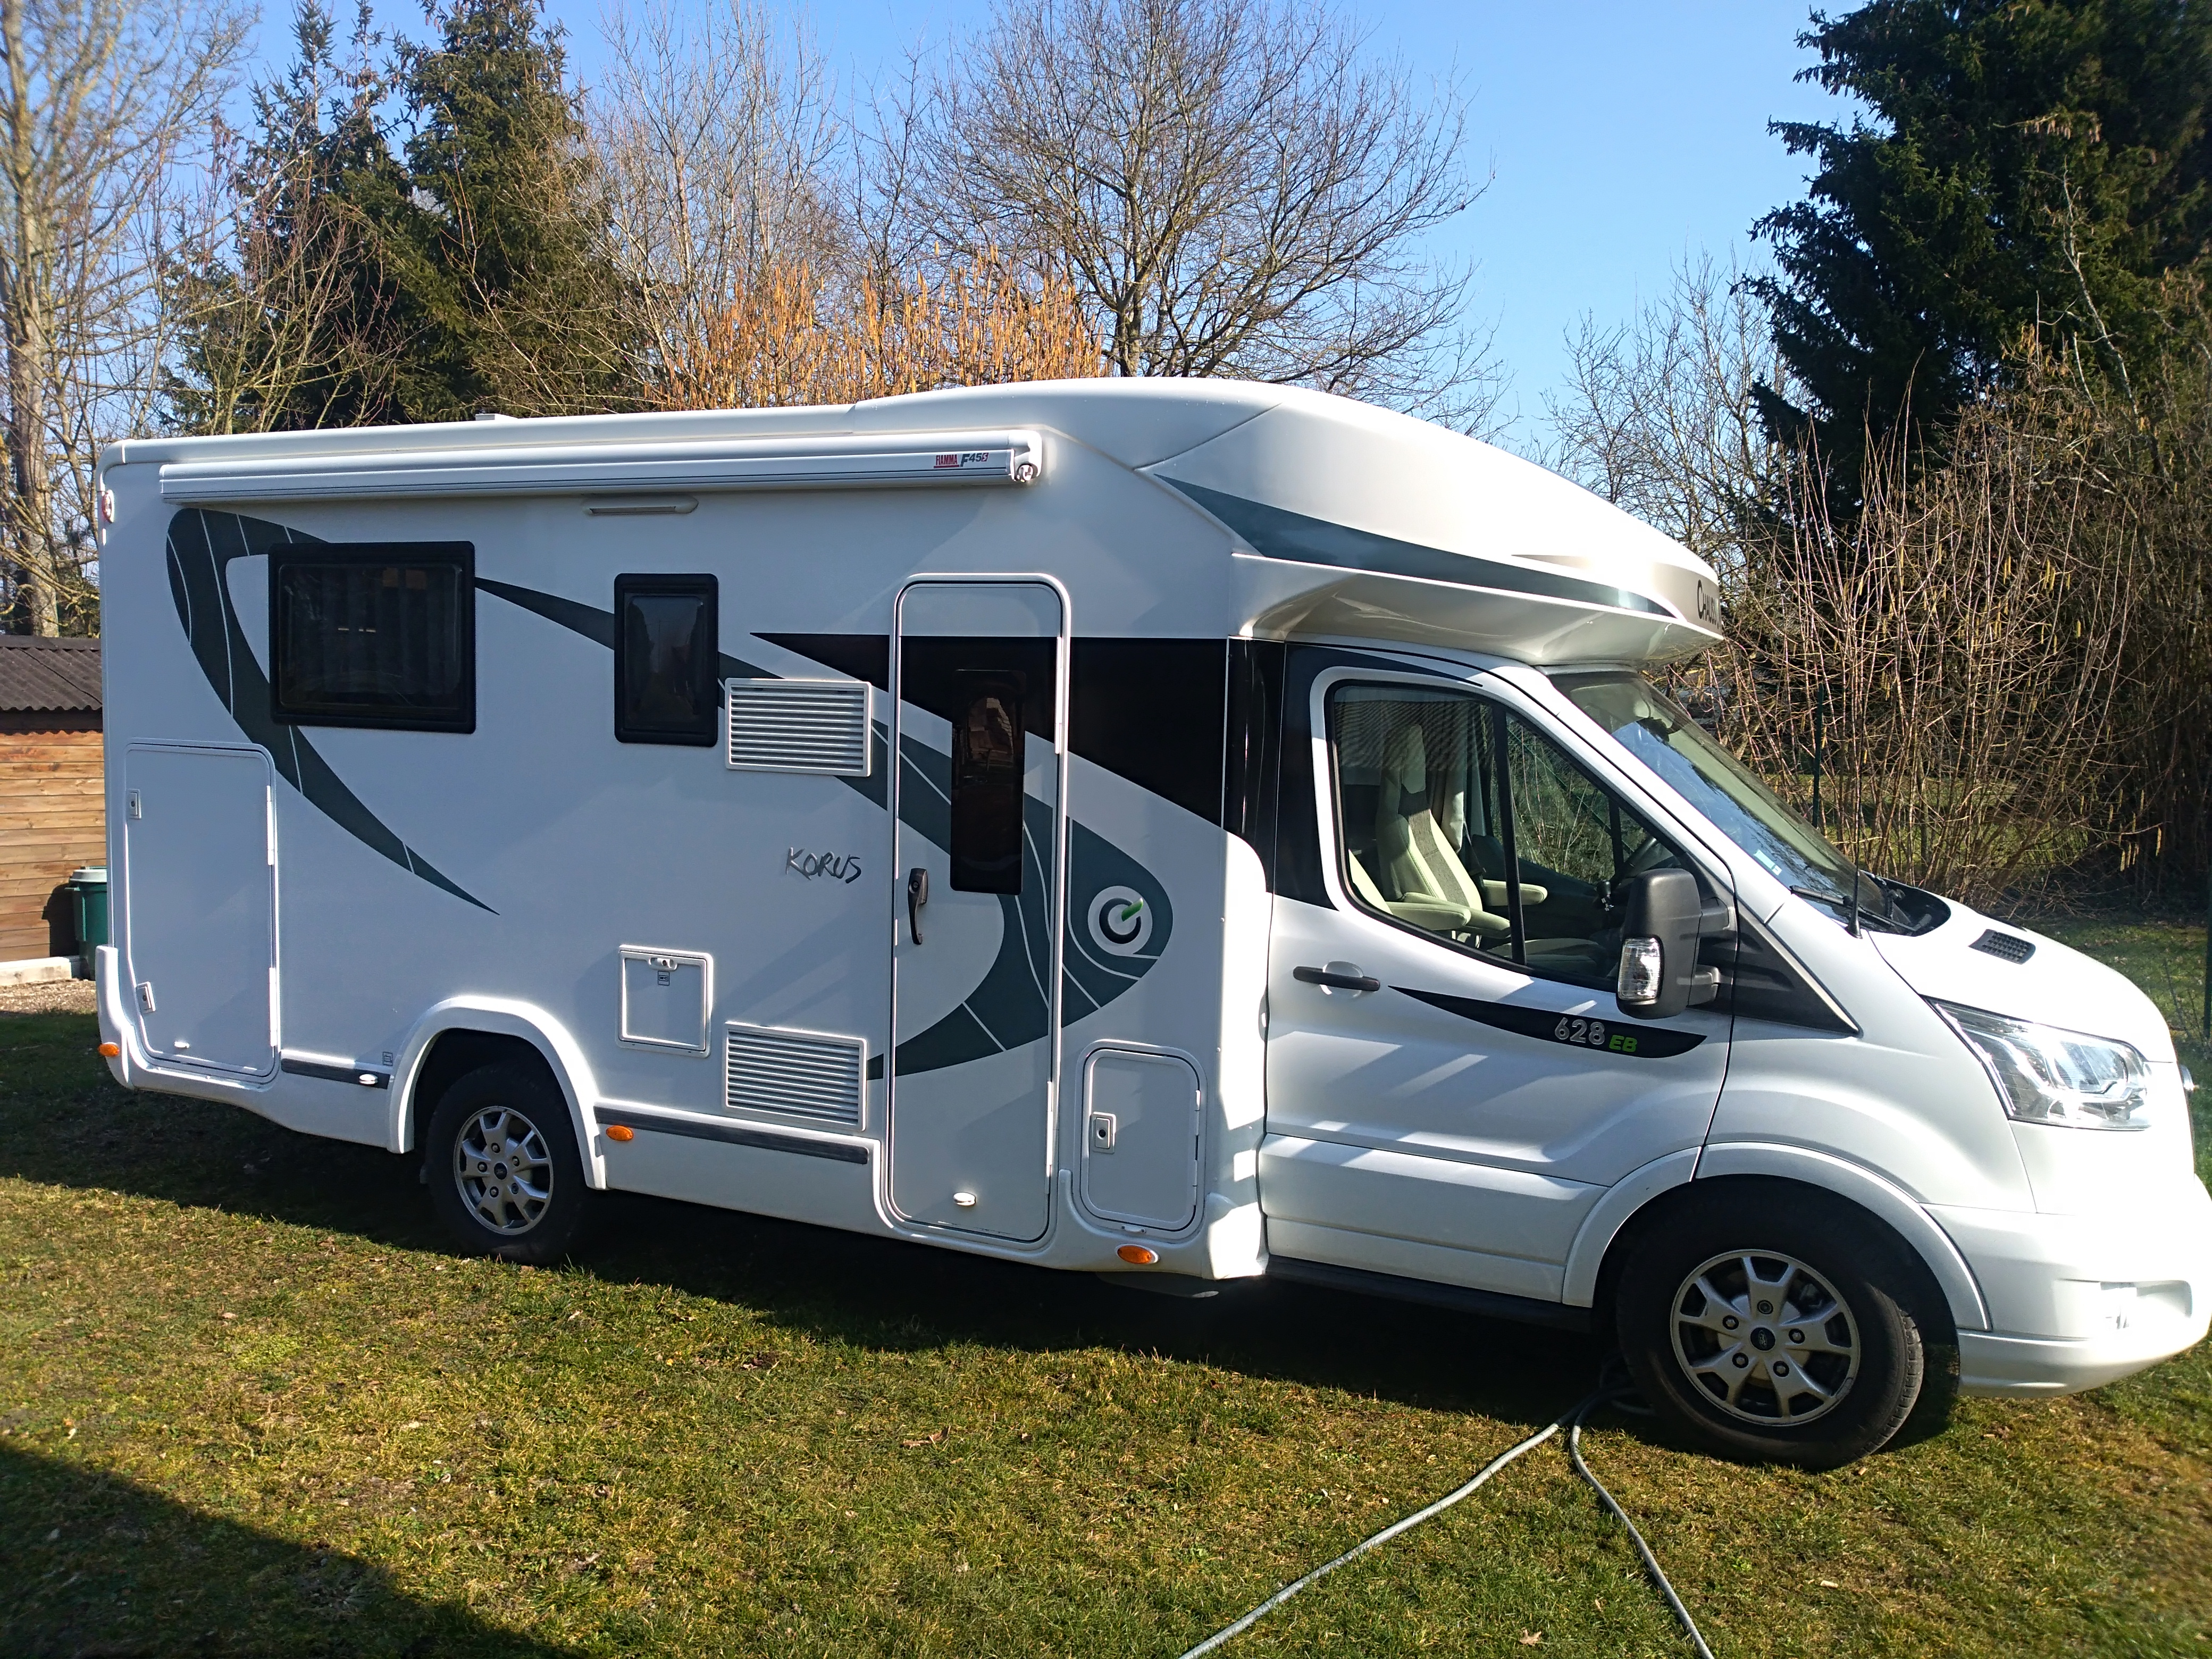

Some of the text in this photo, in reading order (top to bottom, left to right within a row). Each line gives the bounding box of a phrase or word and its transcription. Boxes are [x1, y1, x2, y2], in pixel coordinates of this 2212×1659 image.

[935, 454, 958, 466] FIAMMA
[785, 847, 862, 884] KORUS
[1554, 1017, 1638, 1052] 628 EB
